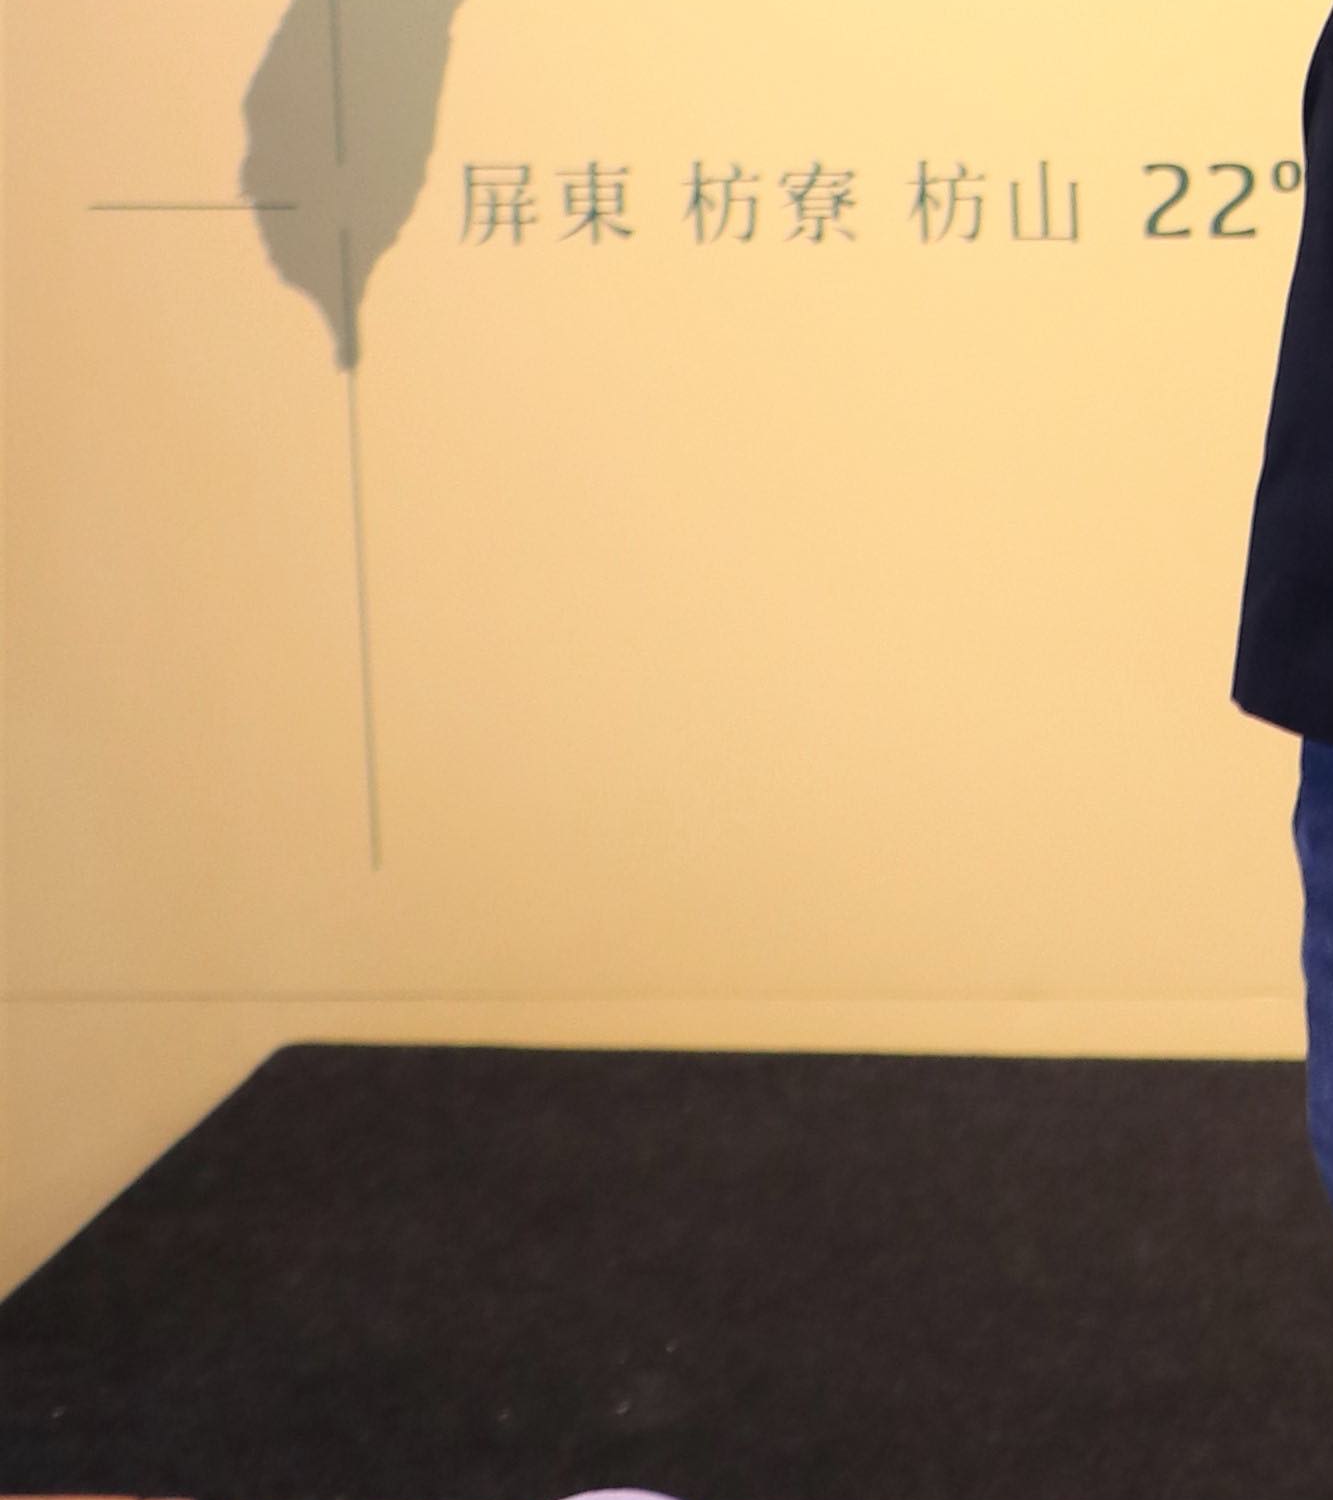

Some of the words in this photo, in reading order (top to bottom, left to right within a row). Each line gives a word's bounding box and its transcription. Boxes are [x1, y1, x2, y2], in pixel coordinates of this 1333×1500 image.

[458, 160, 634, 246] 屏東
[681, 158, 859, 244] 枋寮
[905, 158, 1081, 244] 枋山
